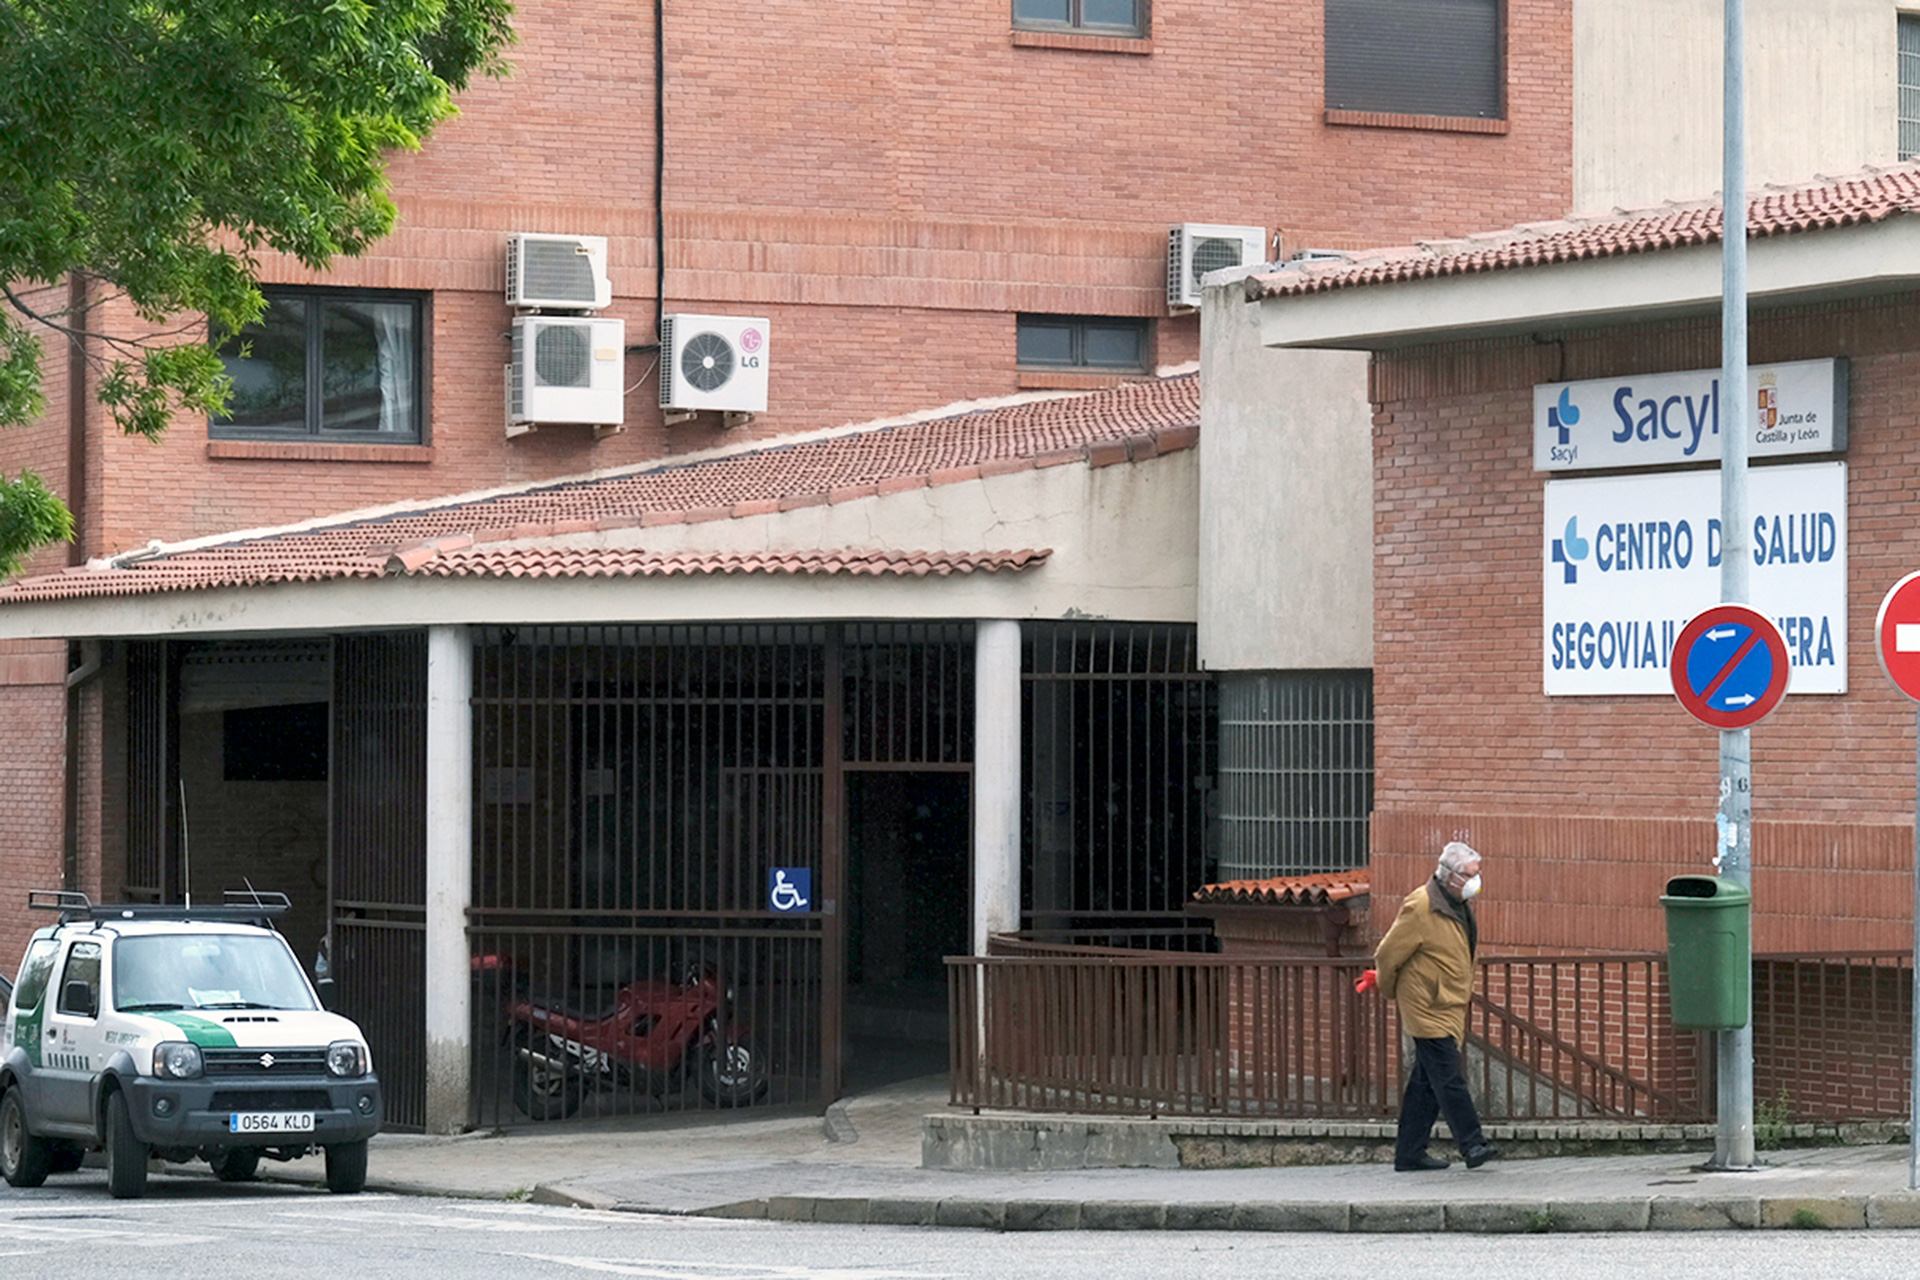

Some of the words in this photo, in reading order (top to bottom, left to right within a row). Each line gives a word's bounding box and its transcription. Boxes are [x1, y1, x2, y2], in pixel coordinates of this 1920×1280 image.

[741, 356, 760, 369] LG
[1612, 379, 1720, 457] Sacyl
[1779, 413, 1803, 426] Junta
[1805, 411, 1817, 423] de
[1755, 430, 1788, 444] Castilla
[1789, 431, 1797, 444] y
[1798, 427, 1820, 440] León
[1550, 445, 1578, 465] Sacyl
[1596, 519, 1693, 573] CENTRO
[1707, 518, 1722, 568] D
[1753, 512, 1836, 567] SALUD
[242, 1115, 278, 1130] 0564
[284, 1114, 311, 1129] KLD
